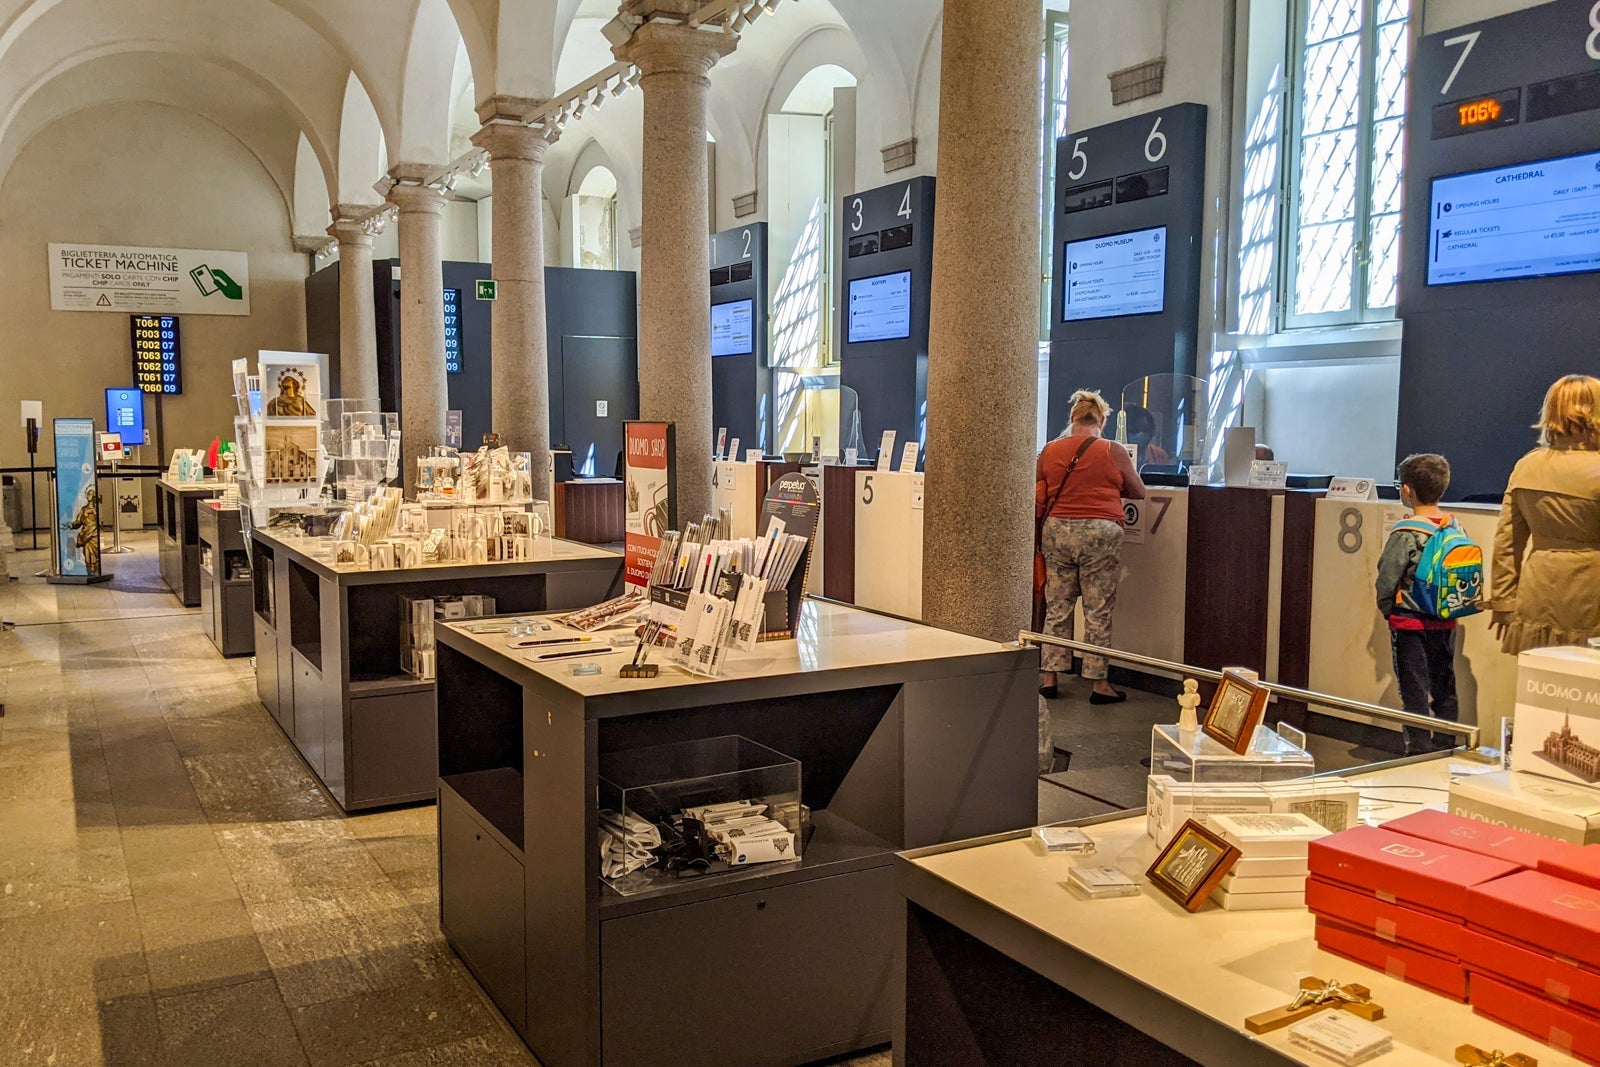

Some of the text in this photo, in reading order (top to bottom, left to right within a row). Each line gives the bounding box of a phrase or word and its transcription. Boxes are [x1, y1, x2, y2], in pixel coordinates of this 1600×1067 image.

[1440, 30, 1482, 95] 7
[1458, 100, 1501, 125] T064
[1144, 116, 1167, 162] 6
[1068, 136, 1088, 180] 5
[1495, 170, 1544, 184] CATHEDRAL
[897, 184, 912, 220] 4
[1456, 198, 1500, 210] OPENING HOURS
[852, 198, 863, 231] 3
[742, 229, 752, 258] 2
[1095, 238, 1134, 249] DUOMO MUSEUM
[1448, 242, 1478, 250] CATHEDRAL
[61, 250, 178, 262] BIGLIETTERIA AUTOMATICA
[712, 238, 717, 264] 1
[62, 258, 178, 272] TICKET MACHINE
[444, 292, 456, 301] 07
[444, 304, 456, 312] 09
[136, 319, 173, 328] T064 07
[445, 316, 456, 324] 07
[136, 330, 174, 339] F003 09
[445, 328, 456, 336] 07
[136, 340, 174, 350] F002 07
[446, 340, 457, 348] 09
[137, 351, 174, 361] T063 07
[446, 351, 458, 359] 07
[138, 362, 175, 371] T062 09
[446, 362, 458, 371] 09
[138, 373, 176, 382] T061 07
[138, 384, 176, 393] T060 09
[629, 438, 666, 458] DUOMO SHOP
[712, 466, 719, 489] 4
[778, 480, 806, 492] perpetua
[862, 476, 874, 504] 5
[1150, 496, 1172, 534] 7
[1337, 507, 1363, 554] 8
[1527, 680, 1582, 701] DUOMO
